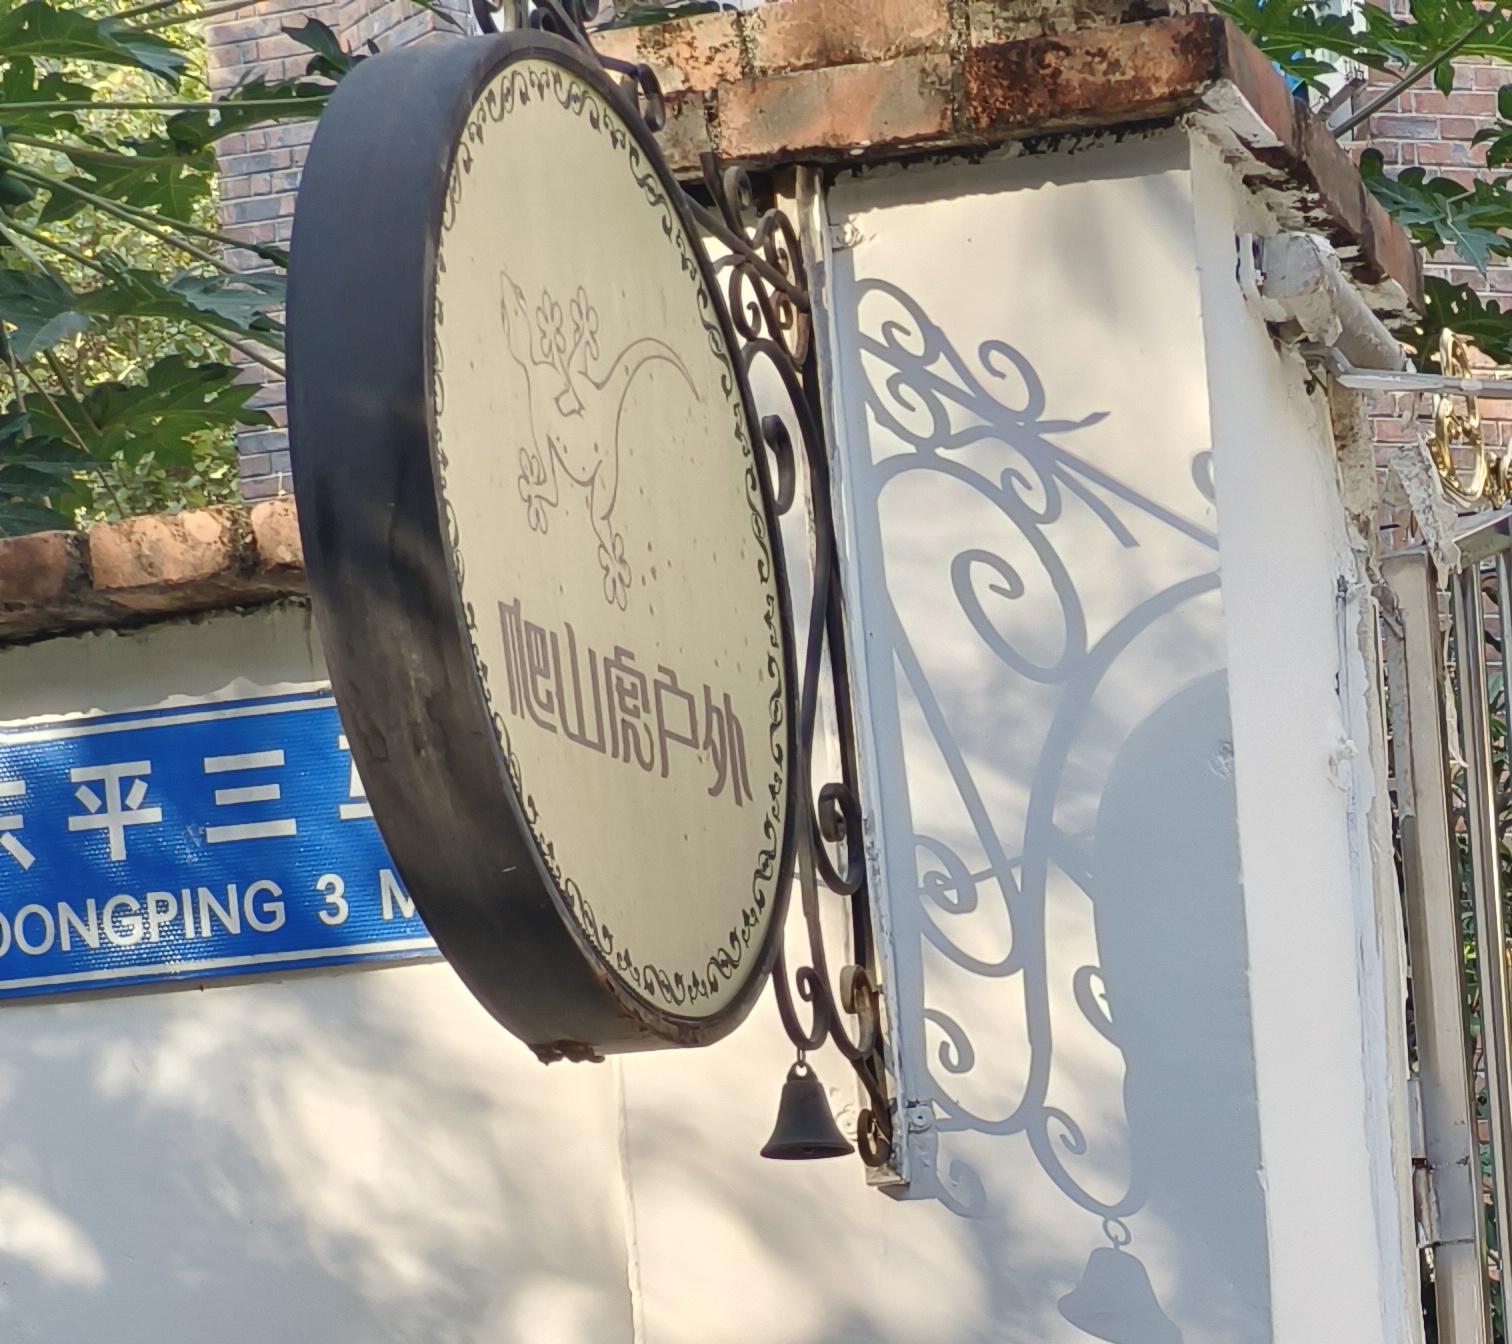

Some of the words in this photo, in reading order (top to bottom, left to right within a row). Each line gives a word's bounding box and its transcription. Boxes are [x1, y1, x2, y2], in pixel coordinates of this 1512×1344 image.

[497, 597, 754, 808] 爬山虎户外
[315, 873, 349, 926] 3
